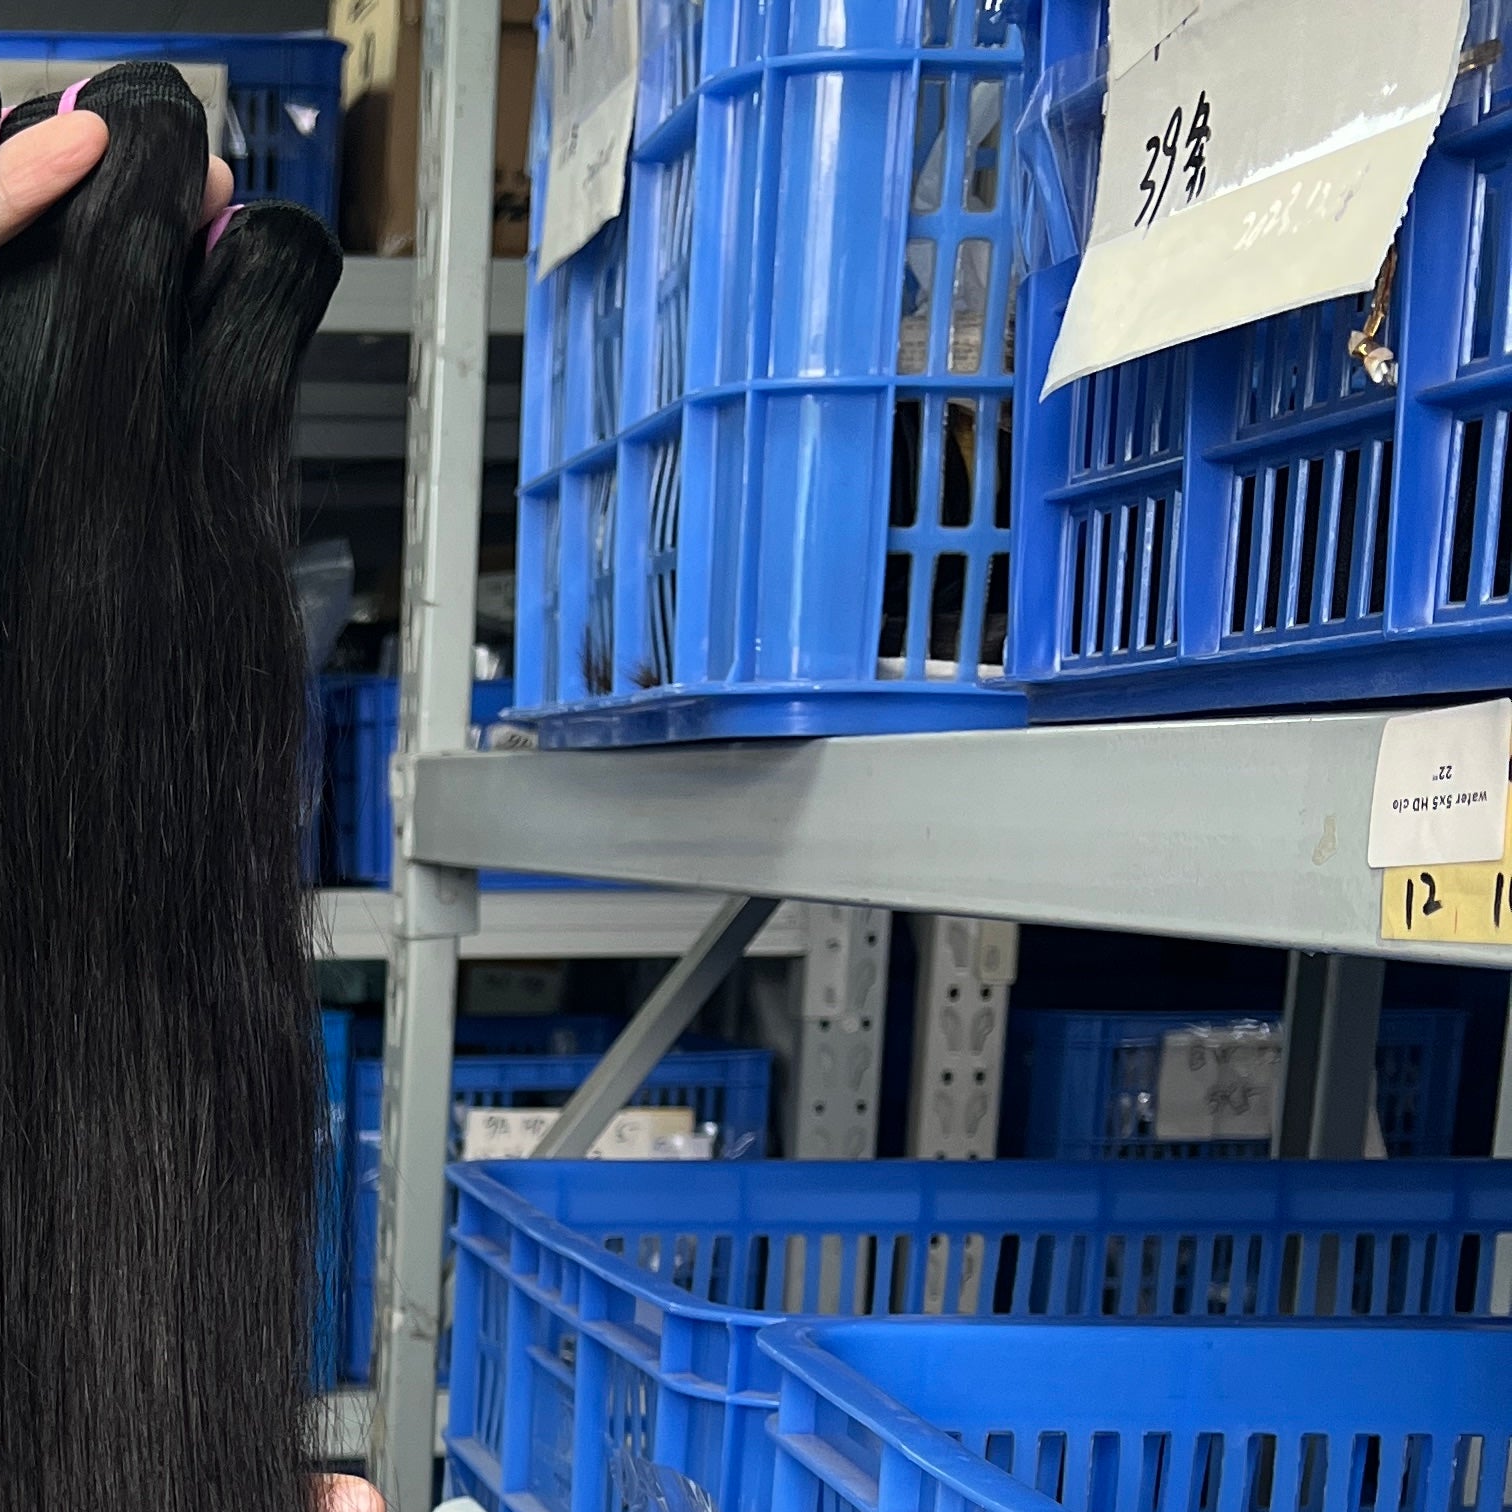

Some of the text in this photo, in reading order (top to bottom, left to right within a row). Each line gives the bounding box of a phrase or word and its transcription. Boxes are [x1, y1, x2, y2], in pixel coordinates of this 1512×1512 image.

[1392, 790, 1487, 814] water 5x5 HD clo
[1405, 871, 1512, 931] 12 1
